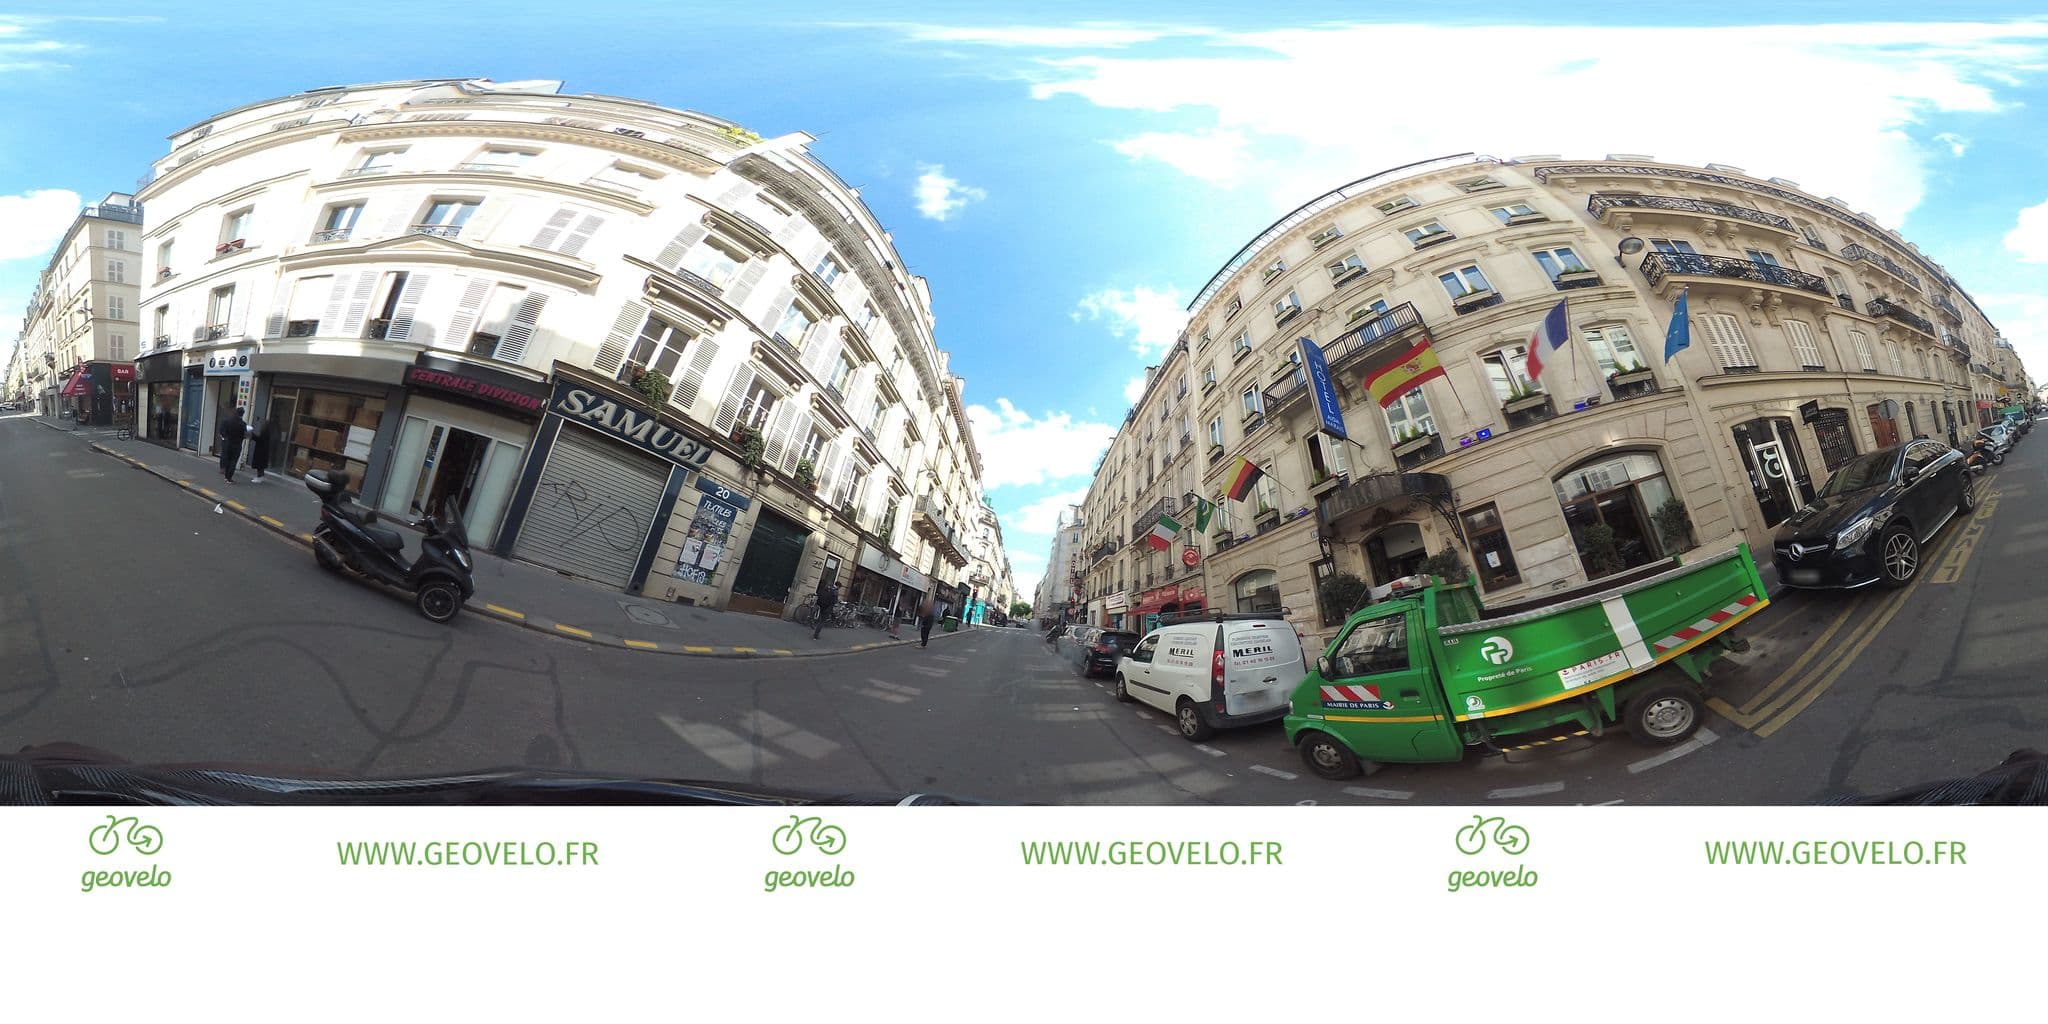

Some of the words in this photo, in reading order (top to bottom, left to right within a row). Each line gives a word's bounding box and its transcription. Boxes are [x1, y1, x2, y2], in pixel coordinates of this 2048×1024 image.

[411, 368, 477, 391] CENTRALE
[478, 383, 541, 409] DIVISION
[1314, 361, 1334, 415] HOTEL
[557, 389, 714, 467] SAMUEL
[716, 486, 730, 500] 20
[703, 500, 733, 518] TEXTILES
[1169, 647, 1195, 656] MERIL
[1232, 645, 1273, 658] MERIL
[1572, 651, 1620, 672] PARIS.FR
[1477, 672, 1506, 682] Propreté
[1515, 665, 1533, 674] Paris
